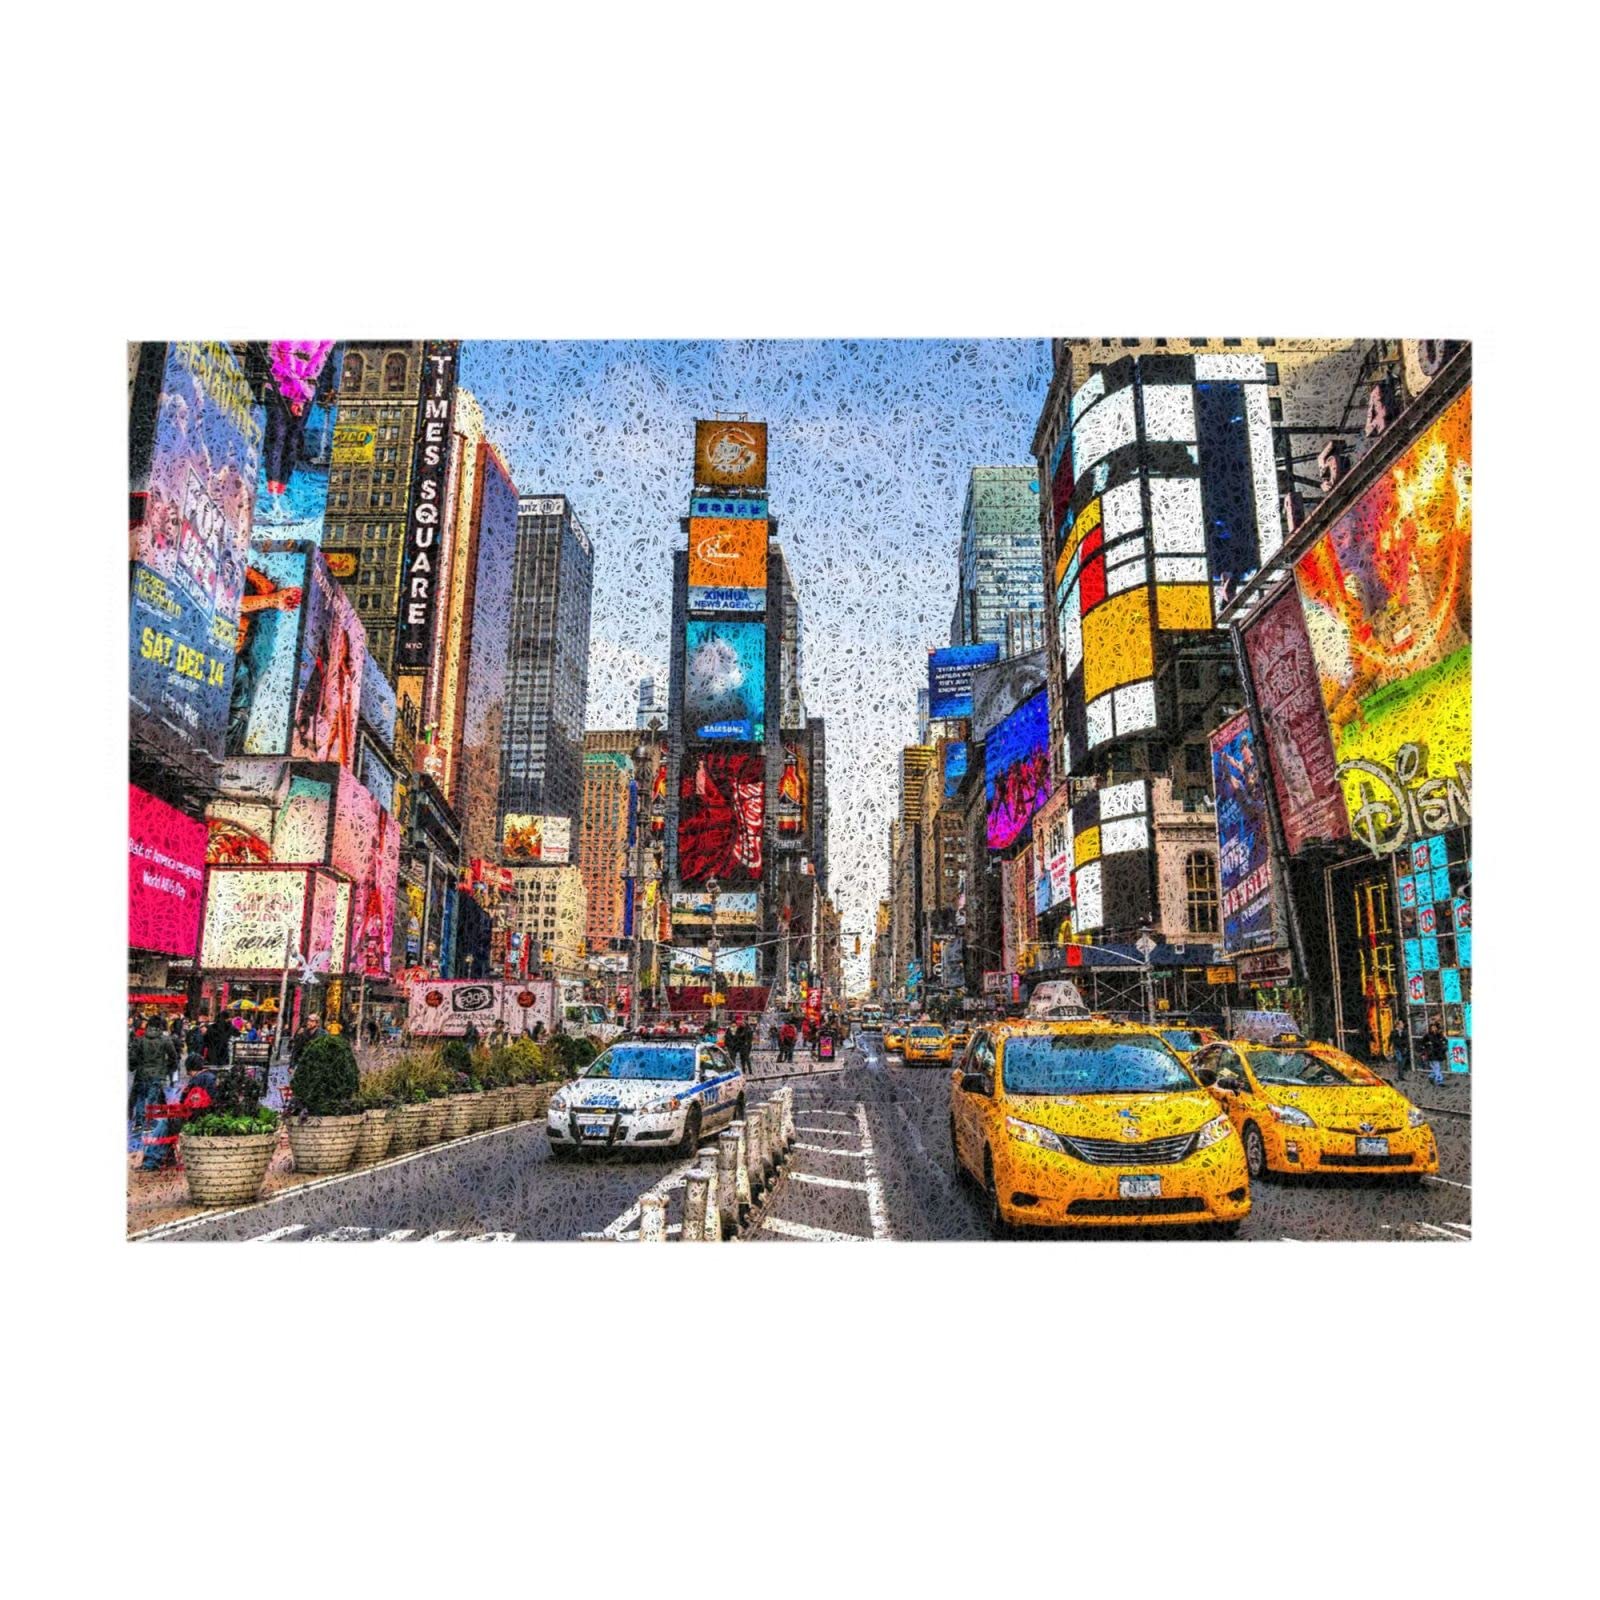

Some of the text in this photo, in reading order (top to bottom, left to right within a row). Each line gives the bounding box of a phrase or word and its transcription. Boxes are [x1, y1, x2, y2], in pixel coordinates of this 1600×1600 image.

[410, 355, 452, 625] TIMES SQUARE
[703, 590, 749, 600] XINHUA
[722, 601, 761, 609] AGENCY
[141, 626, 173, 666] SAT
[176, 643, 205, 680] DEC
[208, 658, 225, 688] 14
[703, 725, 744, 734] SAMSUNG
[733, 781, 764, 868] Coca-Cola
